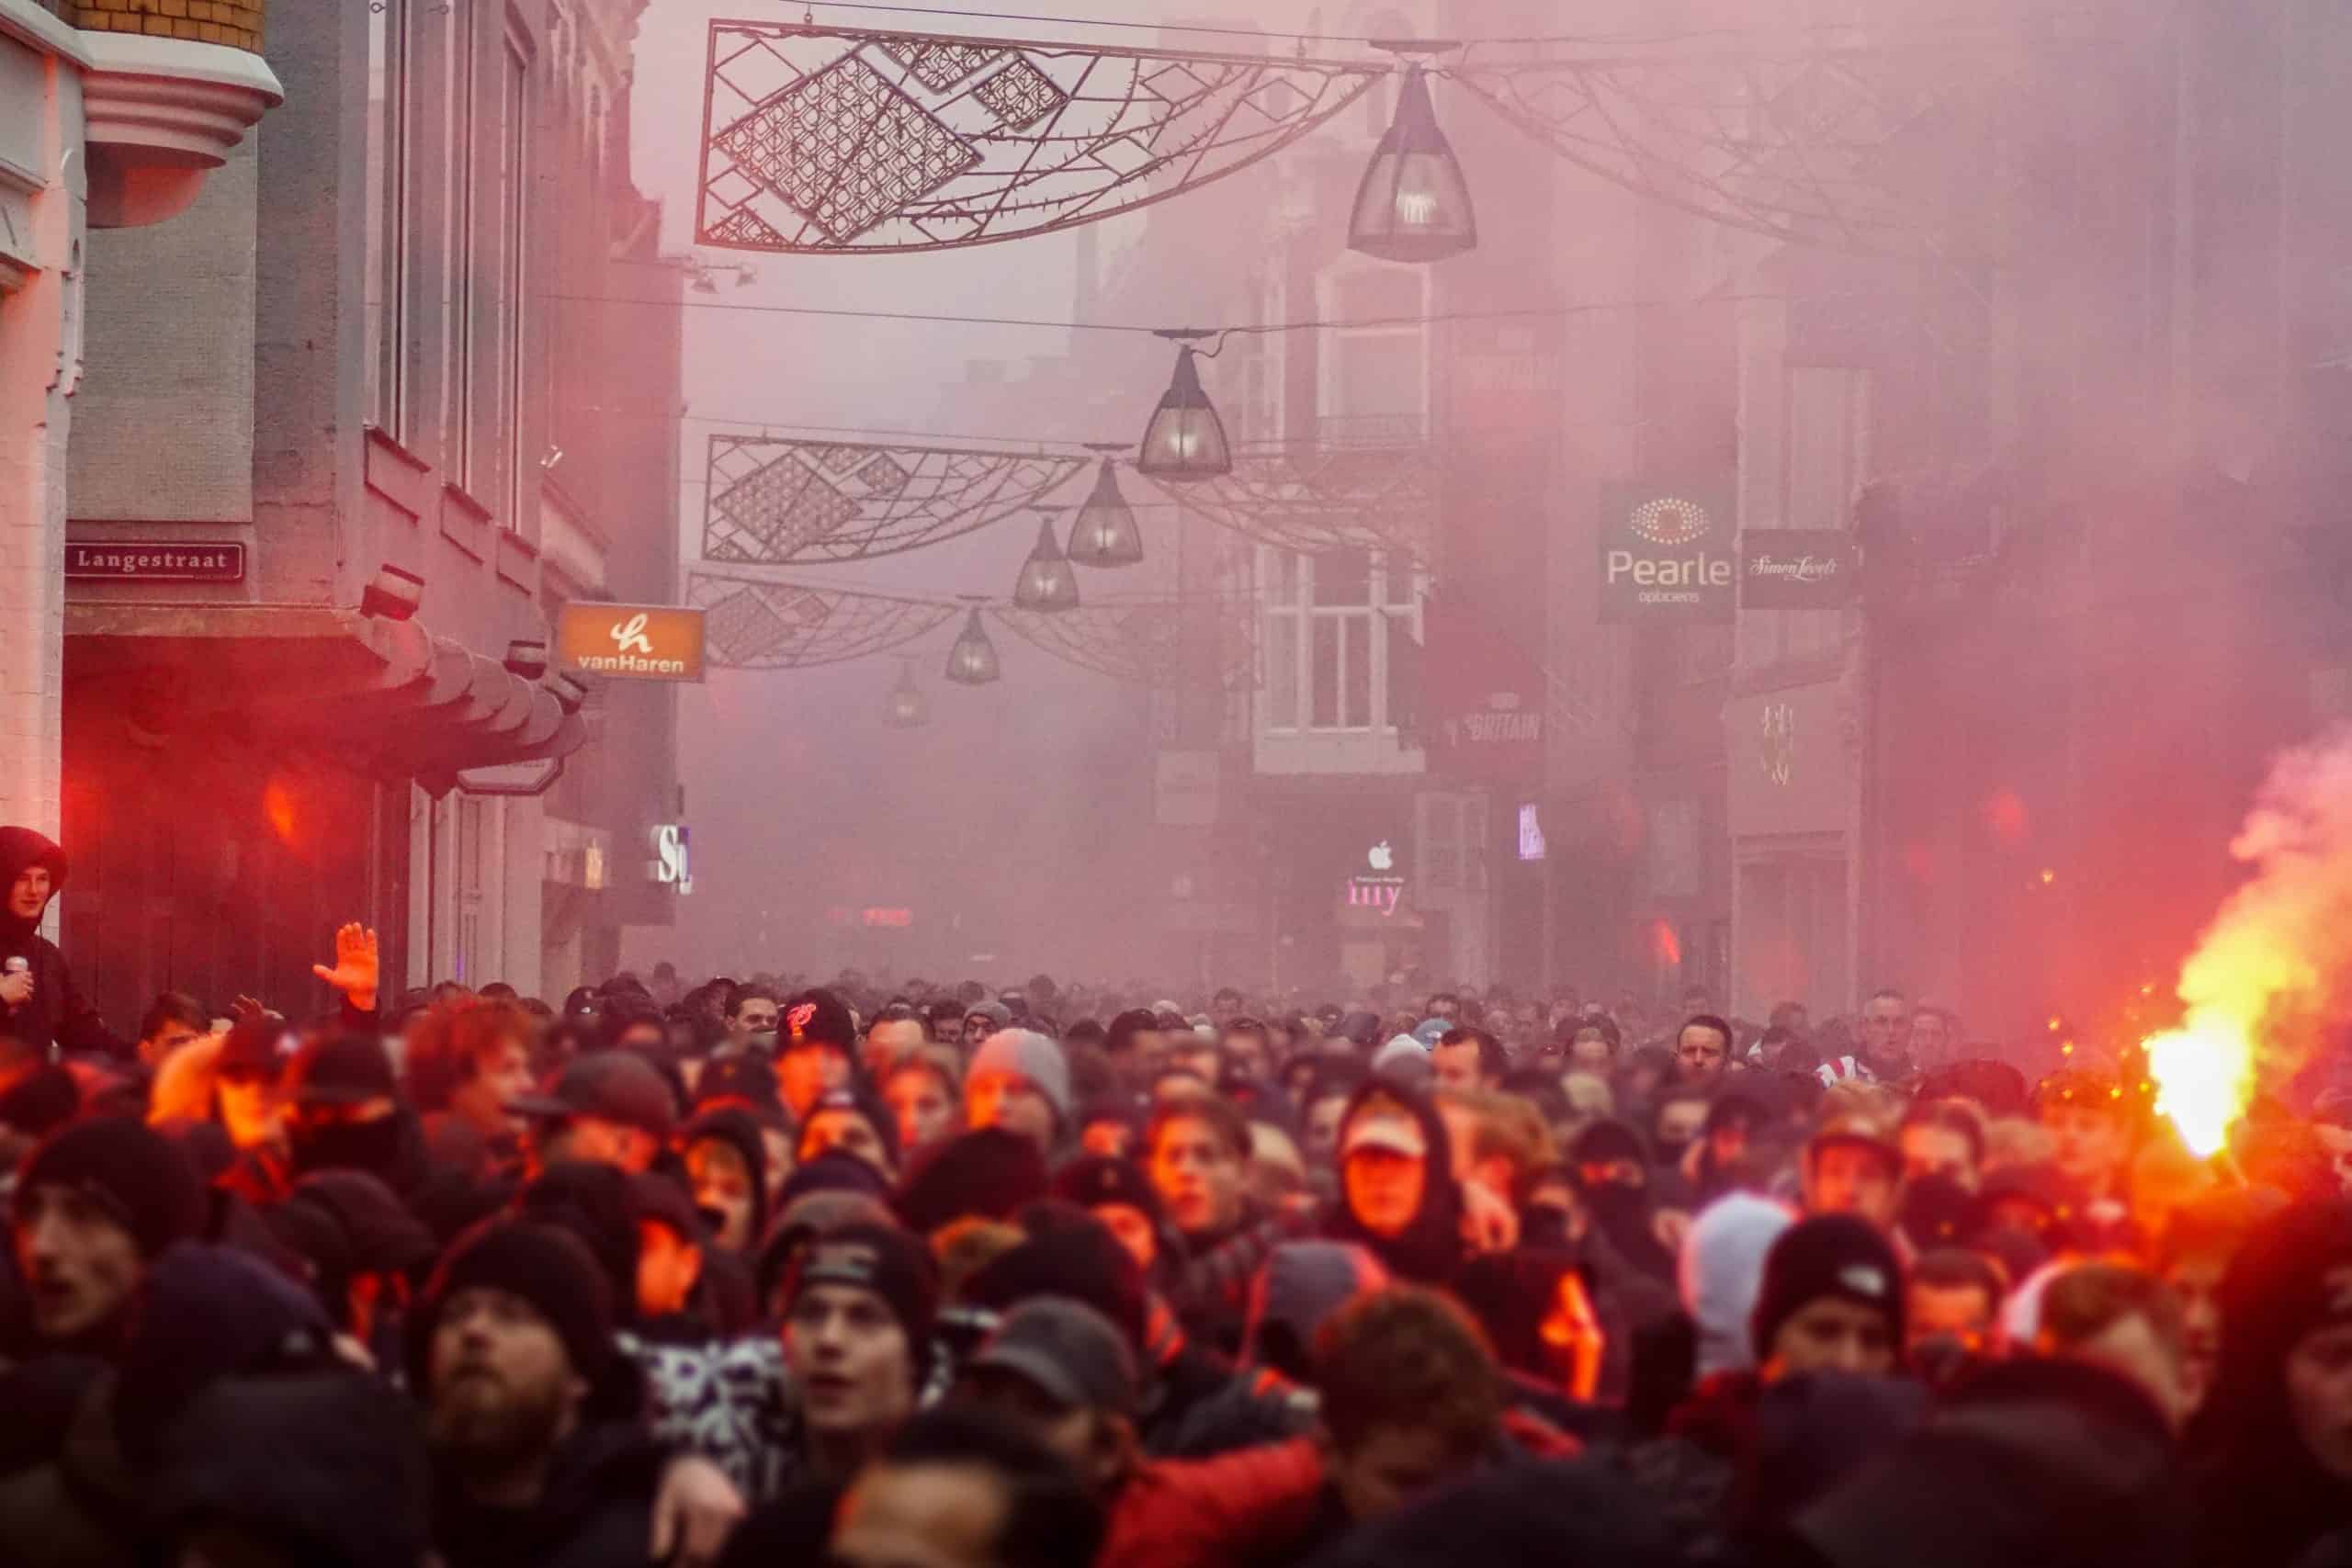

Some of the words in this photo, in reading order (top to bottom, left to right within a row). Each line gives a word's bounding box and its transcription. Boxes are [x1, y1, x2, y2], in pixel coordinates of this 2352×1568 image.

[78, 550, 228, 573] Langestraat
[1607, 550, 1732, 586] Pearle
[1749, 554, 1798, 575] Simon
[577, 654, 684, 673] vanHaren
